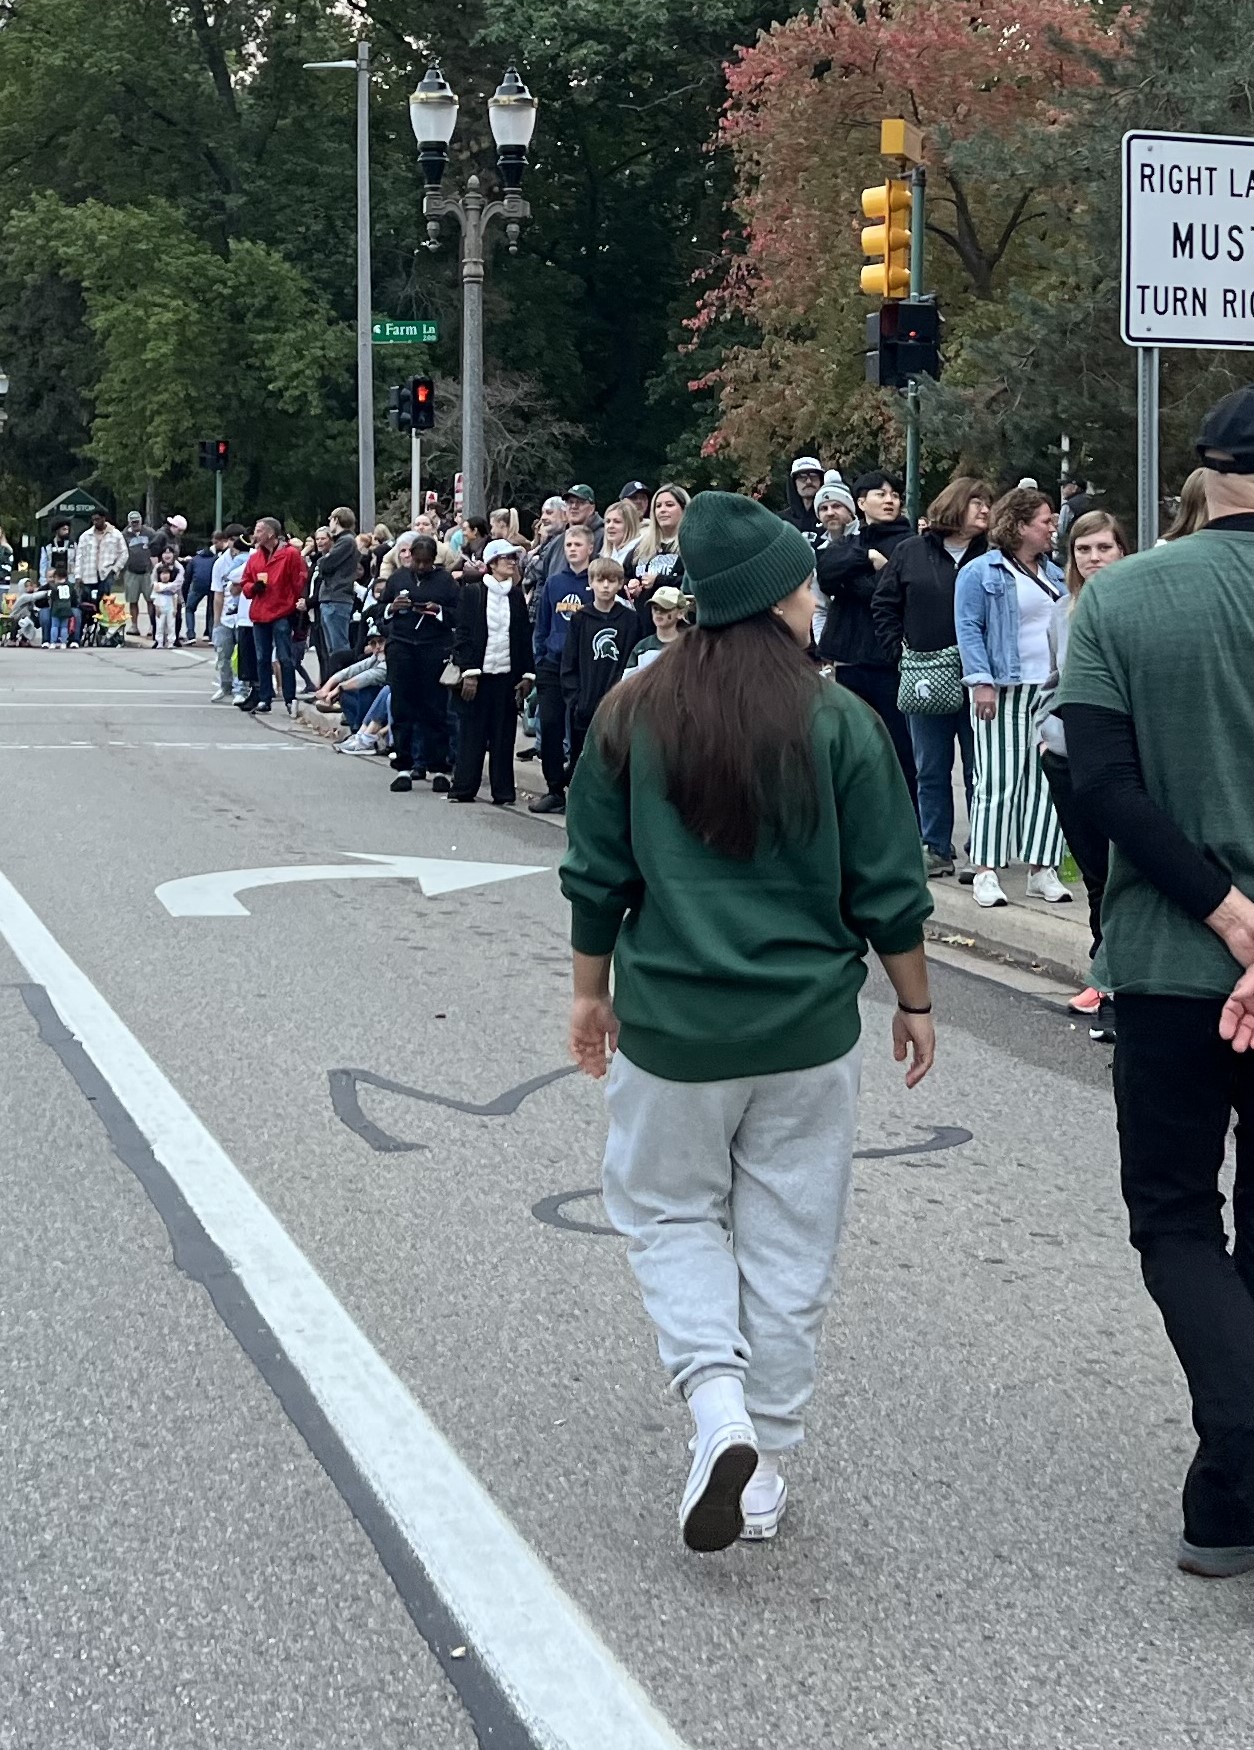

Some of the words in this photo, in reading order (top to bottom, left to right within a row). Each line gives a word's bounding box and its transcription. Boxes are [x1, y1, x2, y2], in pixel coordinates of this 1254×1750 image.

[1140, 163, 1218, 196] RIGHT
[1136, 285, 1207, 316] TURN
[385, 323, 418, 335] Farm
[423, 324, 436, 334] Ln
[76, 504, 96, 512] STOP
